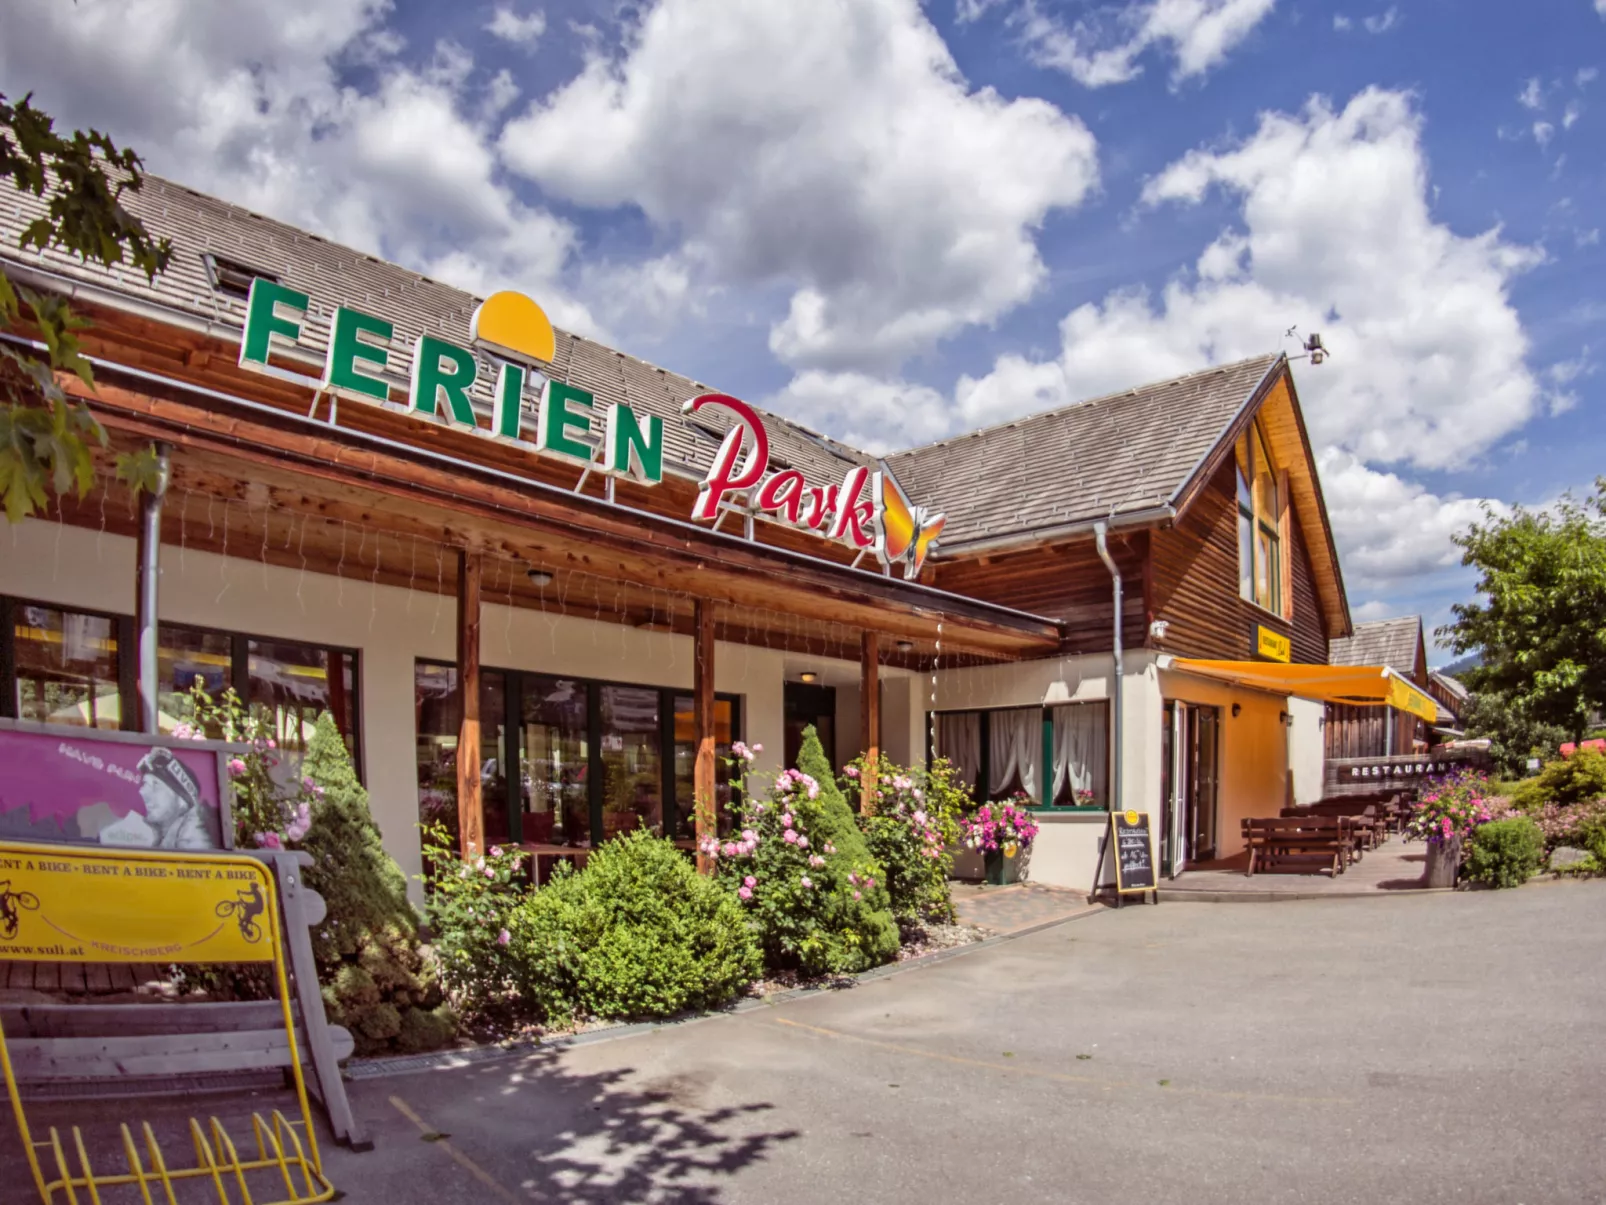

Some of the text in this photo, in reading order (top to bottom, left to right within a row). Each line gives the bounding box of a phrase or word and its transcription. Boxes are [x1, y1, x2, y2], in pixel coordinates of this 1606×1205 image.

[238, 276, 876, 548] FERIEN Park
[1351, 761, 1457, 777] RESTAURANT
[26, 860, 34, 871] A
[38, 861, 72, 873] BIKE
[82, 863, 118, 876] RENT
[123, 866, 132, 876] A
[135, 866, 167, 878] BIKE
[176, 868, 211, 879] RENT
[215, 870, 224, 880] A
[226, 870, 257, 881] BIKE
